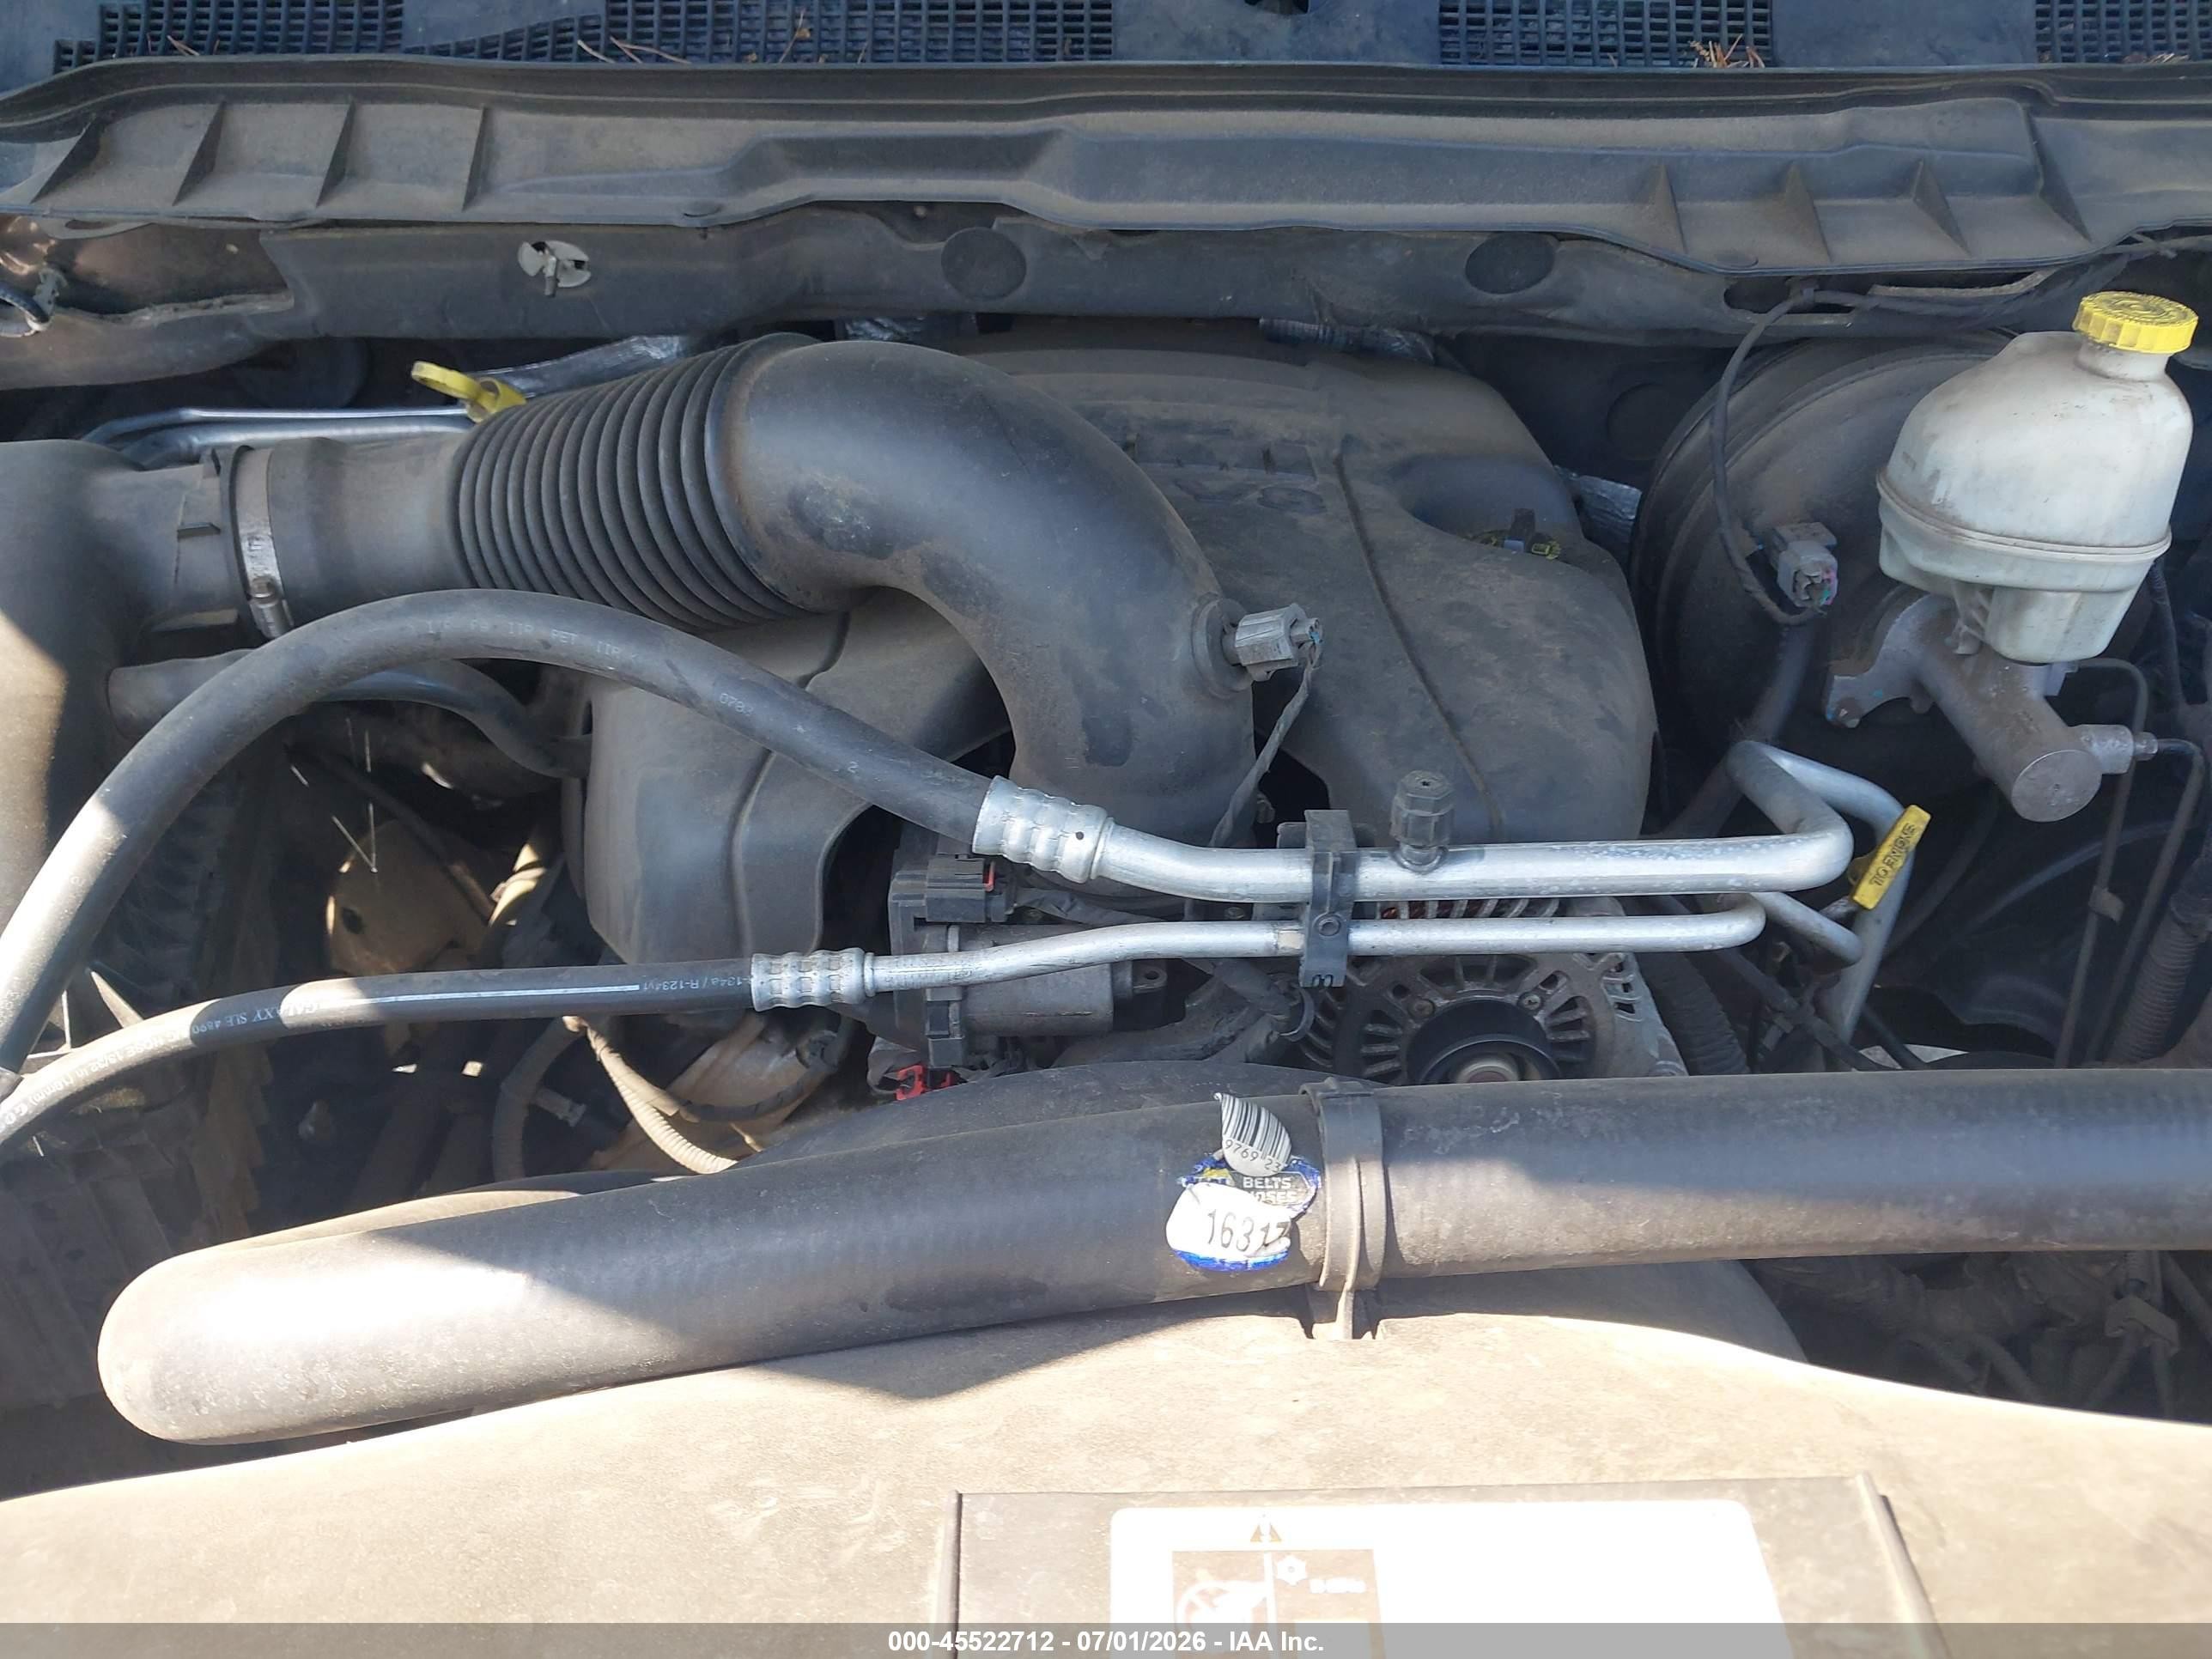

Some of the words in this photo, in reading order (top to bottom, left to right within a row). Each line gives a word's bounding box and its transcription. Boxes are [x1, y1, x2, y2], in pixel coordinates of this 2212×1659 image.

[1882, 823, 1917, 870] ENGINE
[1869, 866, 1888, 885] OIL
[225, 1012, 247, 1026] SLE
[252, 1003, 316, 1022] GALAXY
[191, 1019, 221, 1034] 4890
[128, 1036, 164, 1058] HOSE
[1225, 1139, 1259, 1162] 9769
[1243, 1176, 1291, 1189] BELTS
